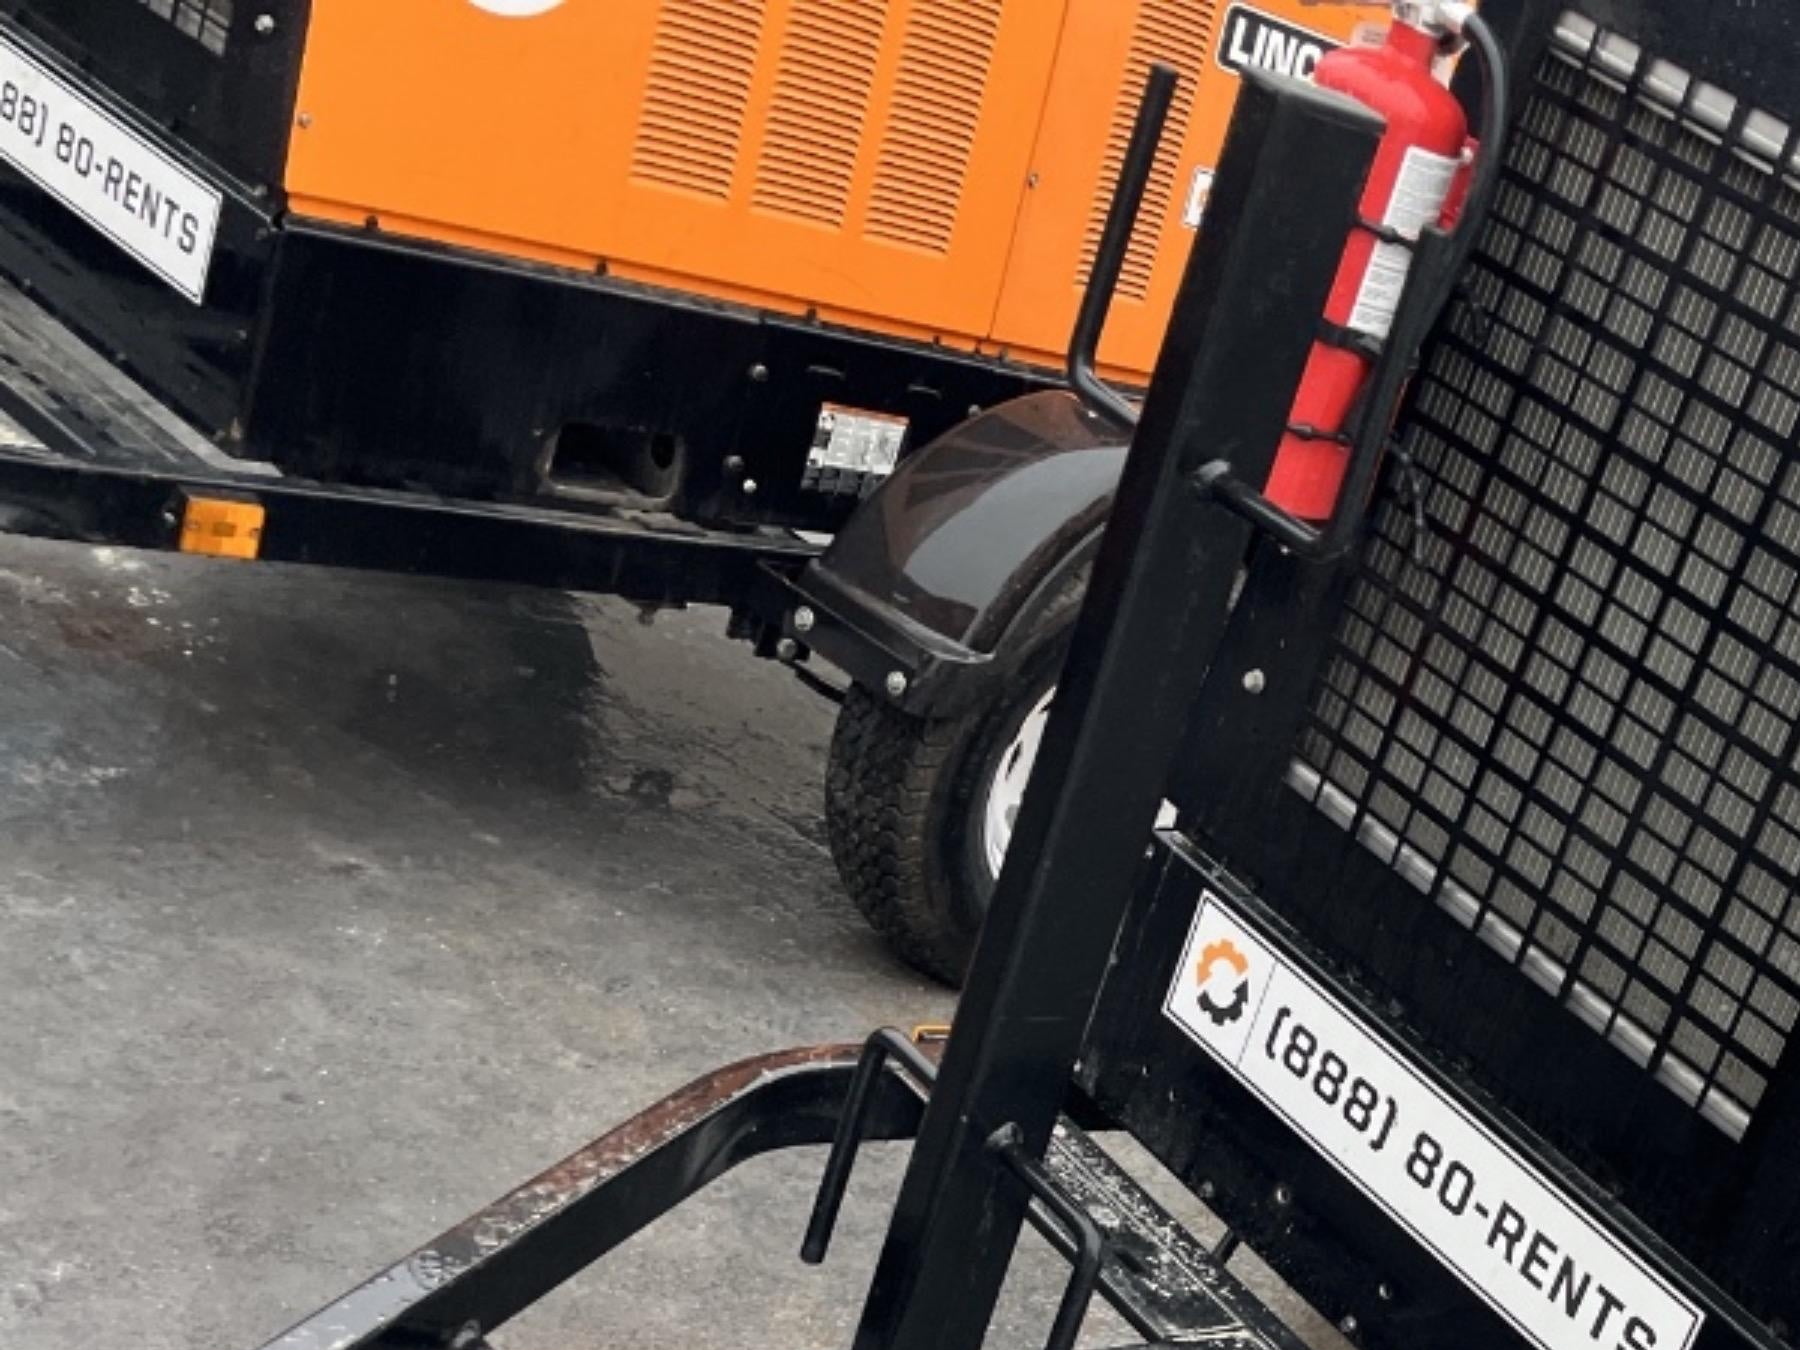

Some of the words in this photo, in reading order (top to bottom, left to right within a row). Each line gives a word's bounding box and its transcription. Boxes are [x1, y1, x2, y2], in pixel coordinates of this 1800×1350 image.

[1227, 15, 1325, 81] LINC
[56, 122, 200, 254] 80-RENTS
[1264, 1006, 1398, 1152] (888)
